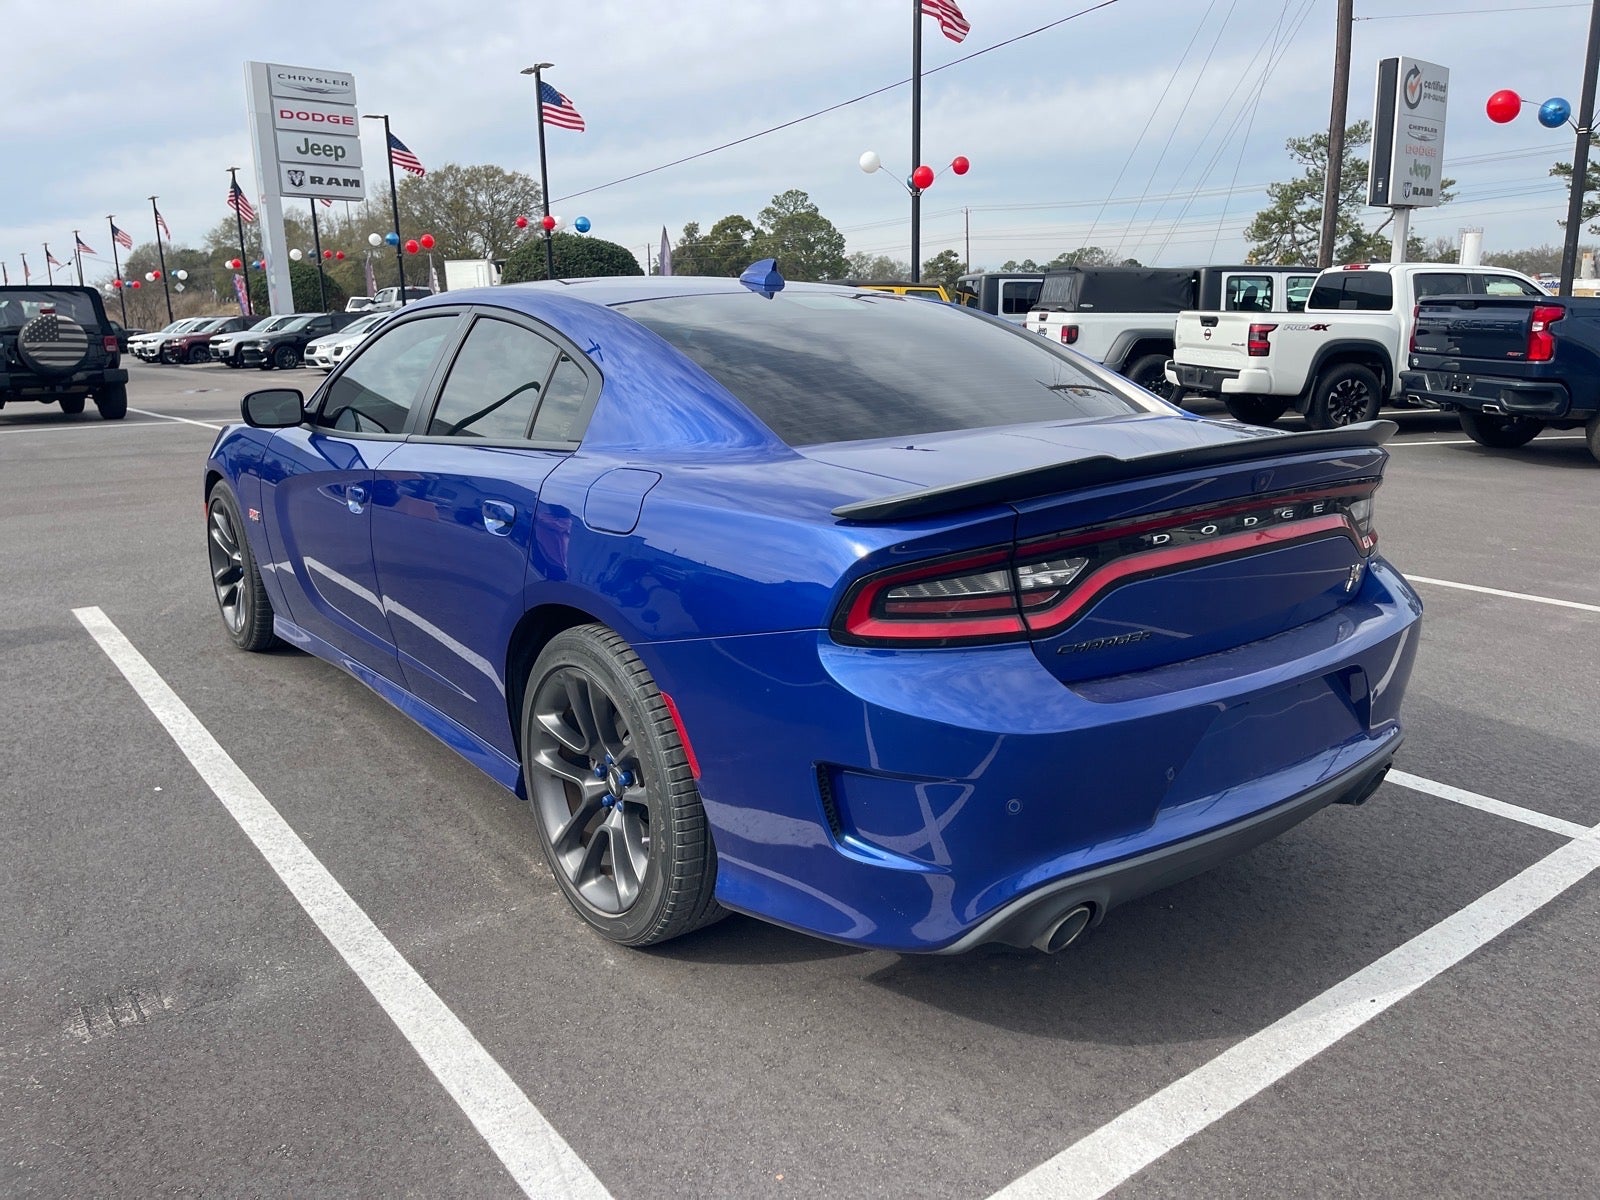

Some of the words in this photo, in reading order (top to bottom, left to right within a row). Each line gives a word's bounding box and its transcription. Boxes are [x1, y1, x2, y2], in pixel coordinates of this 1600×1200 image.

[277, 73, 349, 87] CHRYSLER
[280, 109, 354, 126] DODGE
[296, 137, 346, 161] Jeep
[1409, 159, 1431, 180] Jeep
[309, 175, 361, 188] RAM
[1412, 187, 1433, 197] RAM
[1152, 503, 1325, 545] DODGE
